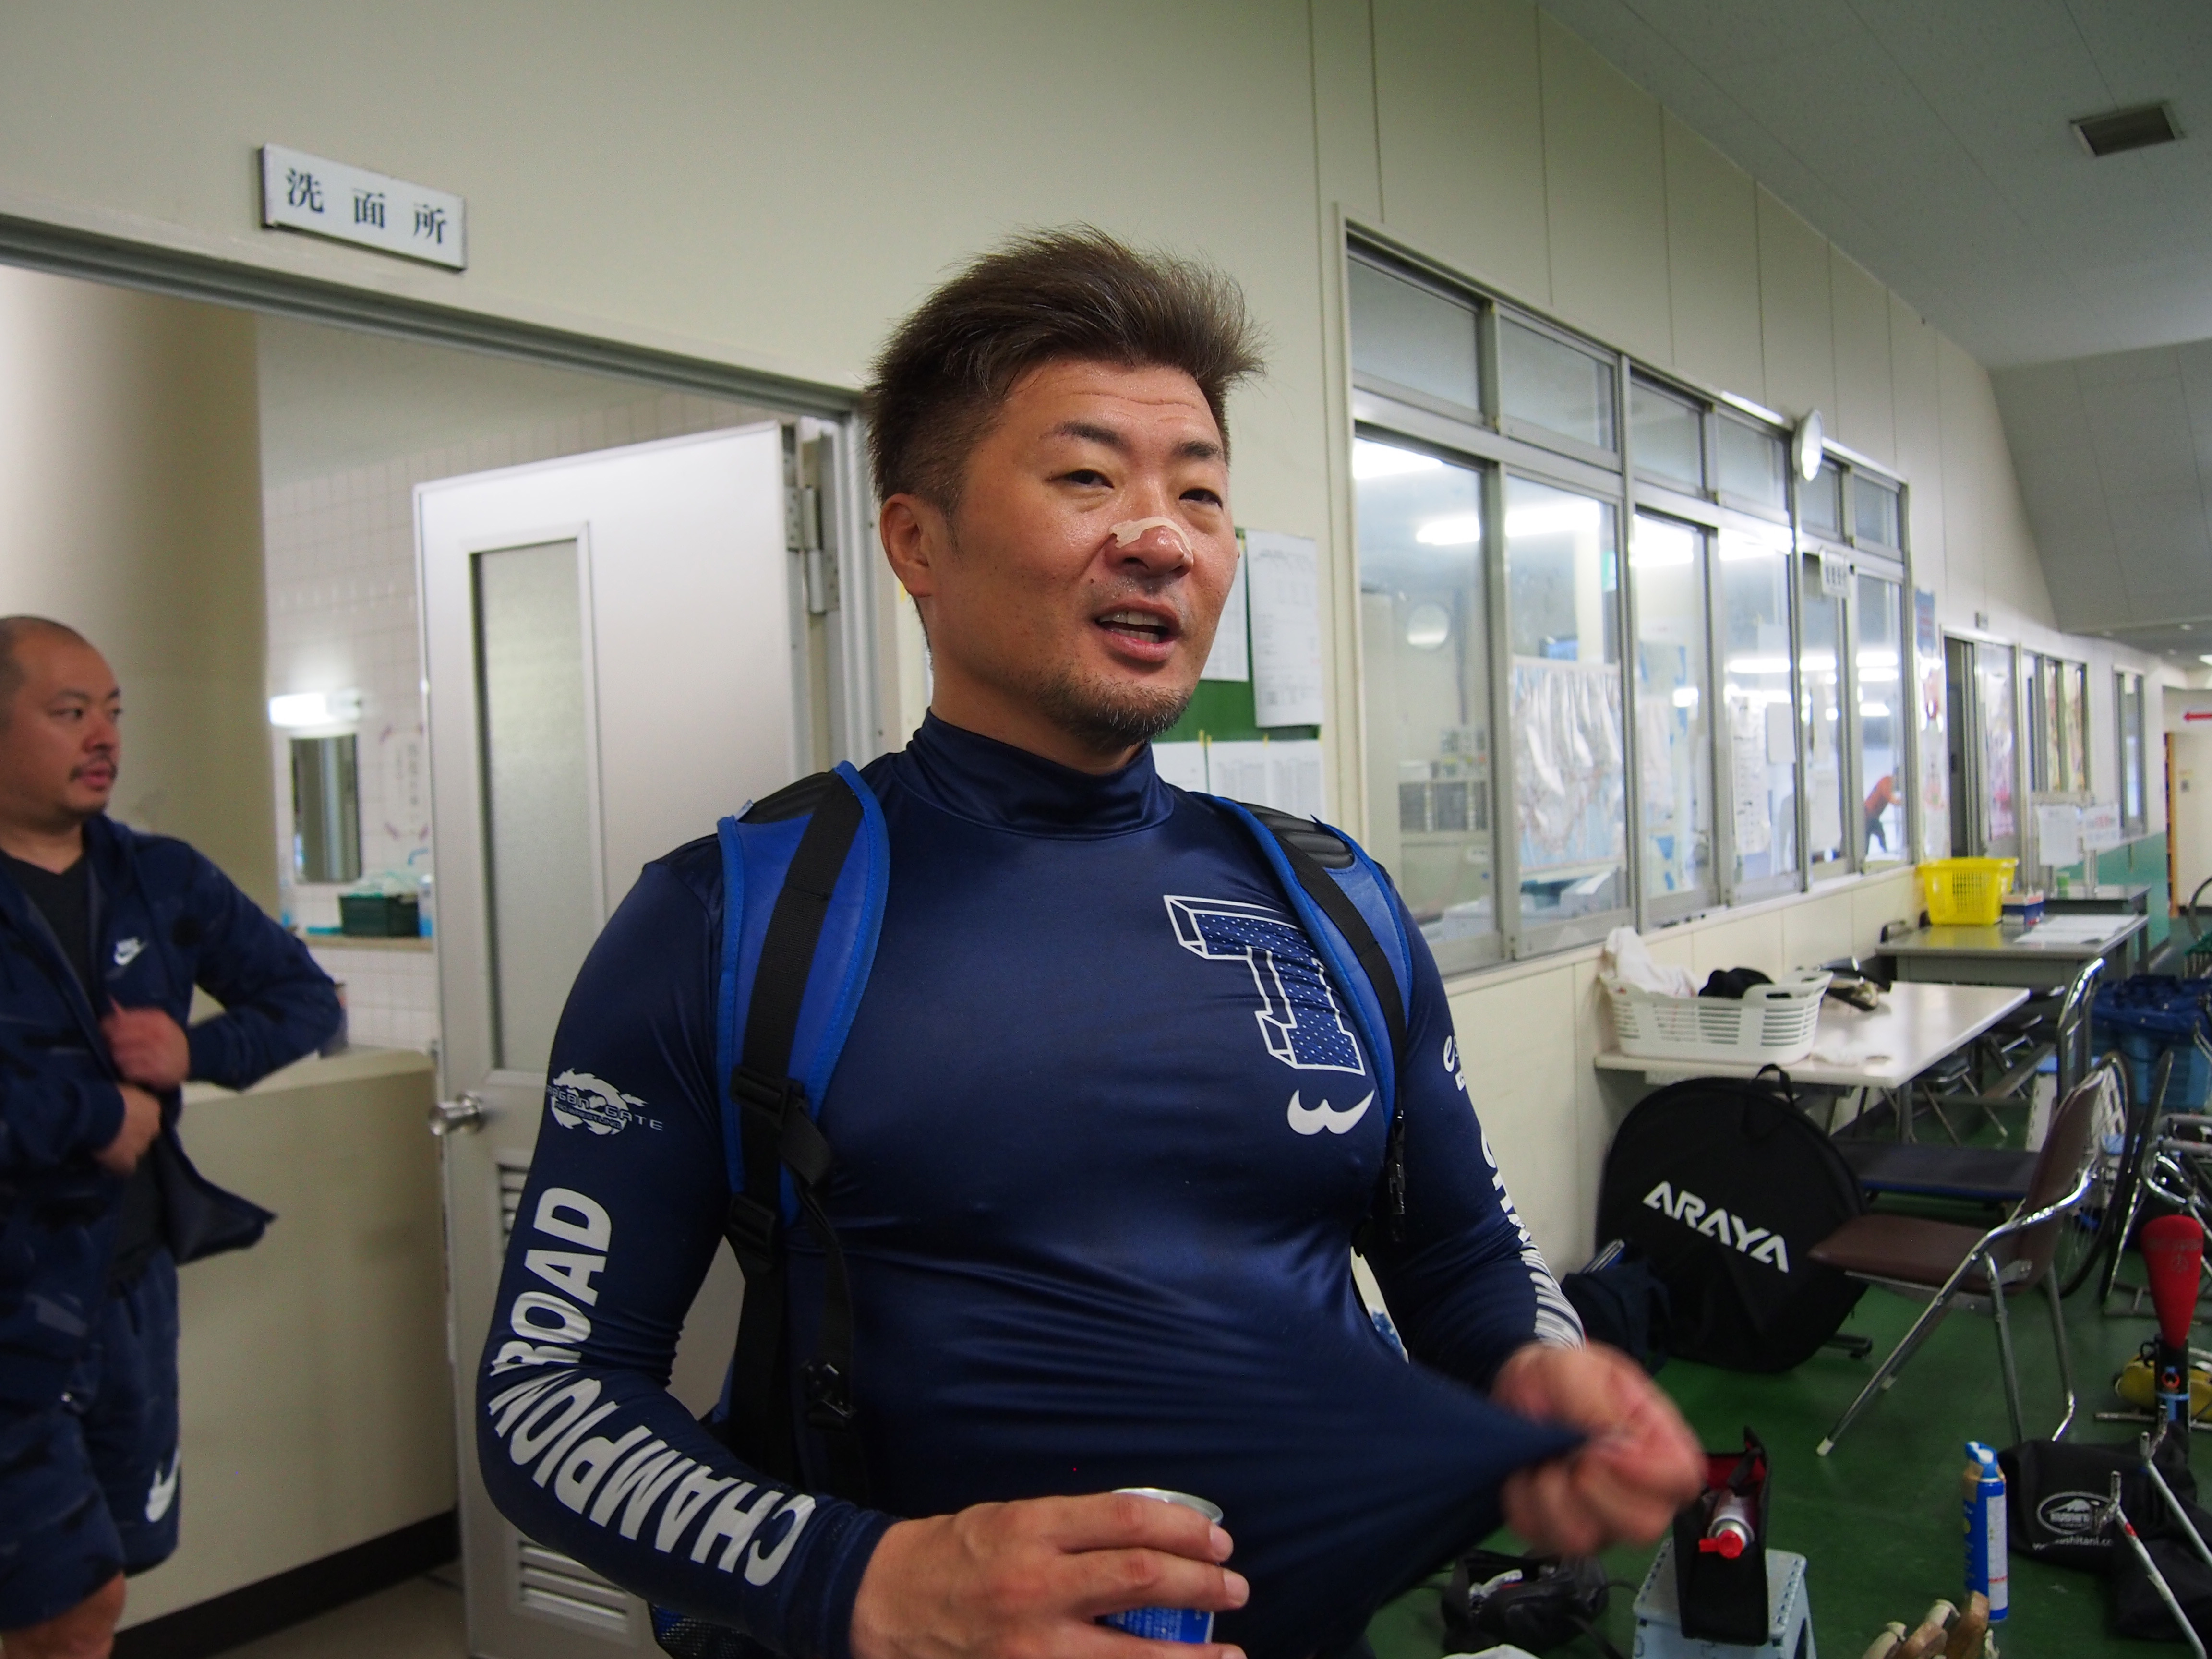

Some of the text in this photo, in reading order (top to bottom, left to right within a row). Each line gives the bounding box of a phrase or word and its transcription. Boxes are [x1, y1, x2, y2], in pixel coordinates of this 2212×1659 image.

[286, 168, 447, 244] 洗面所
[605, 1105, 663, 1131] GATE
[1643, 1181, 1790, 1273] ARAYA
[488, 1368, 816, 1586] CHAMPION
